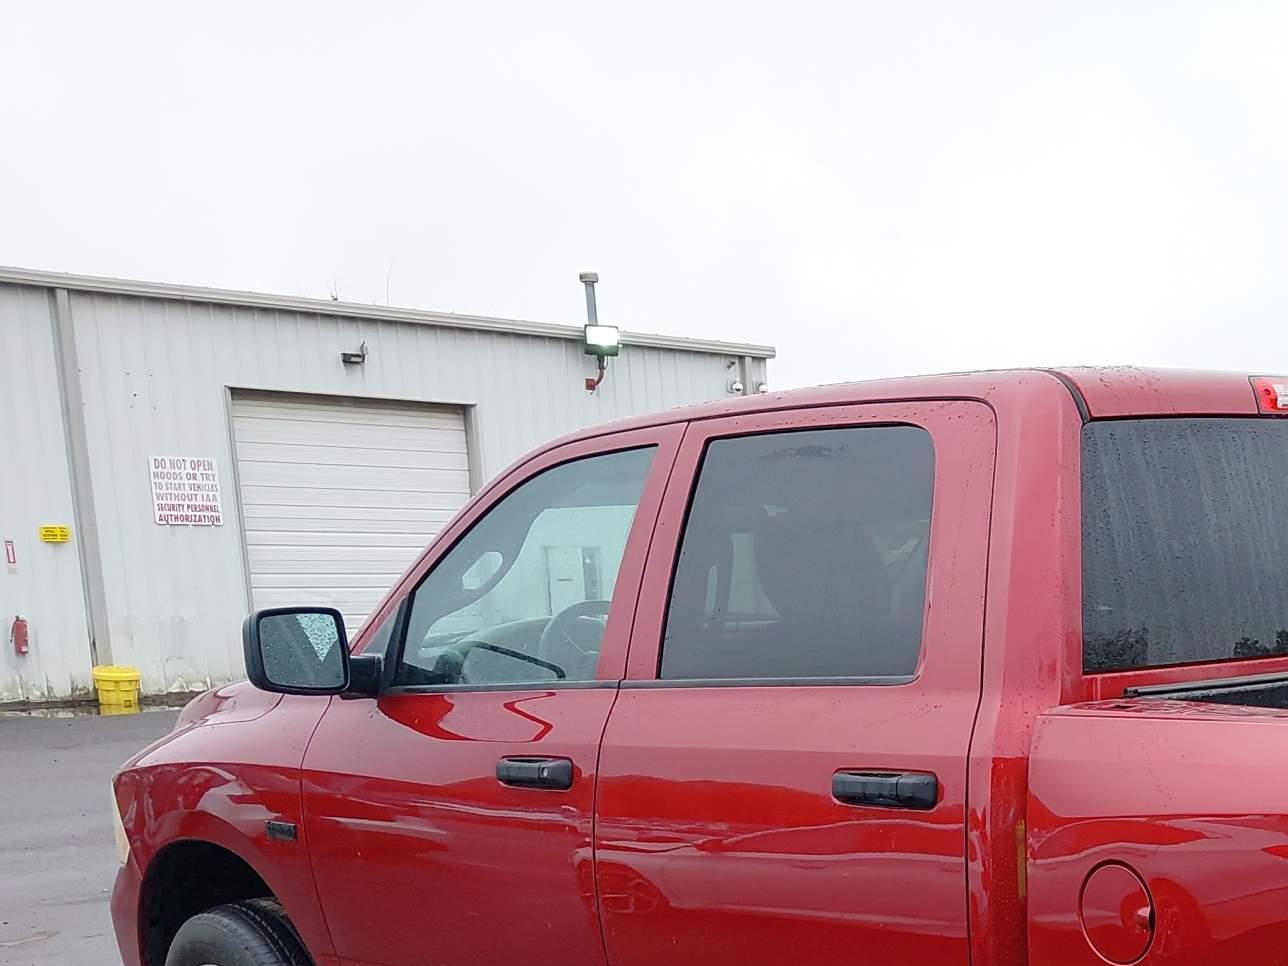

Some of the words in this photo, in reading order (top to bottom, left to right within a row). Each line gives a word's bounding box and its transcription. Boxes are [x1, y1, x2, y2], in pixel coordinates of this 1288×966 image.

[154, 458, 166, 470] DO
[169, 458, 187, 471] NOT
[190, 459, 213, 471] OPEN
[153, 471, 183, 480] HOODS
[186, 472, 198, 481] OR
[200, 472, 216, 481] TRY
[153, 482, 163, 491] TO
[165, 482, 186, 491] START
[188, 483, 218, 492] VEHICLES
[155, 492, 198, 501] WITHOUT
[201, 493, 218, 502] IAA
[157, 503, 185, 512] SECURITY
[186, 503, 219, 513] PERSONNEL
[158, 513, 221, 523] AUTHORIZATION
